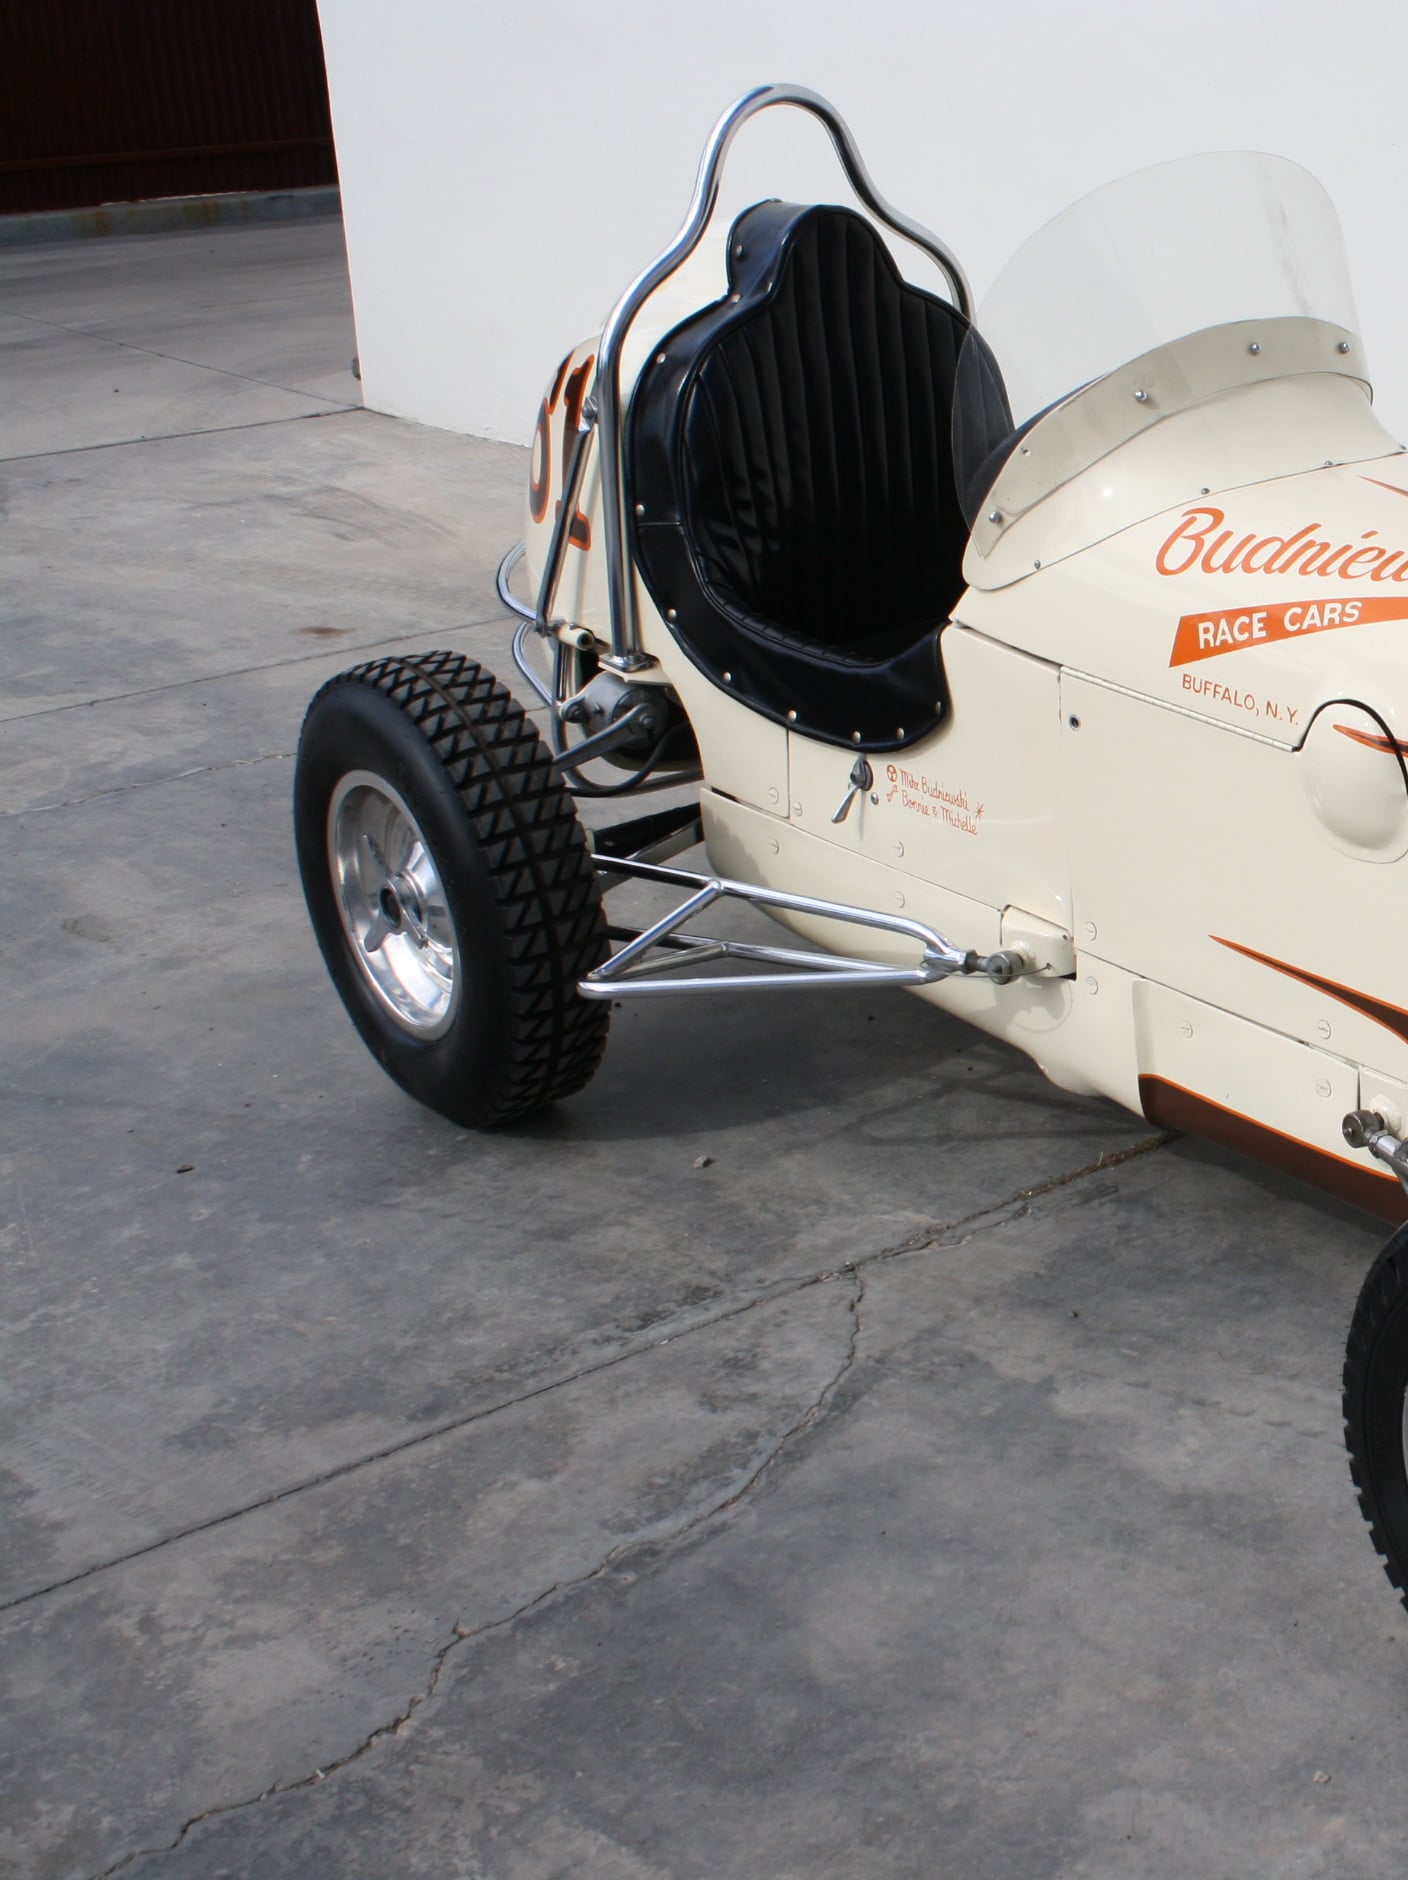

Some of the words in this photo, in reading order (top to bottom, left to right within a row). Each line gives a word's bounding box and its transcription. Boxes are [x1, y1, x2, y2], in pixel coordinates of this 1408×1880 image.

[1198, 611, 1268, 650] RACE
[1283, 600, 1363, 633] CARS
[1181, 673, 1260, 717] BUFFALO,
[899, 768, 921, 792] Mike
[940, 804, 978, 835] Michelle
